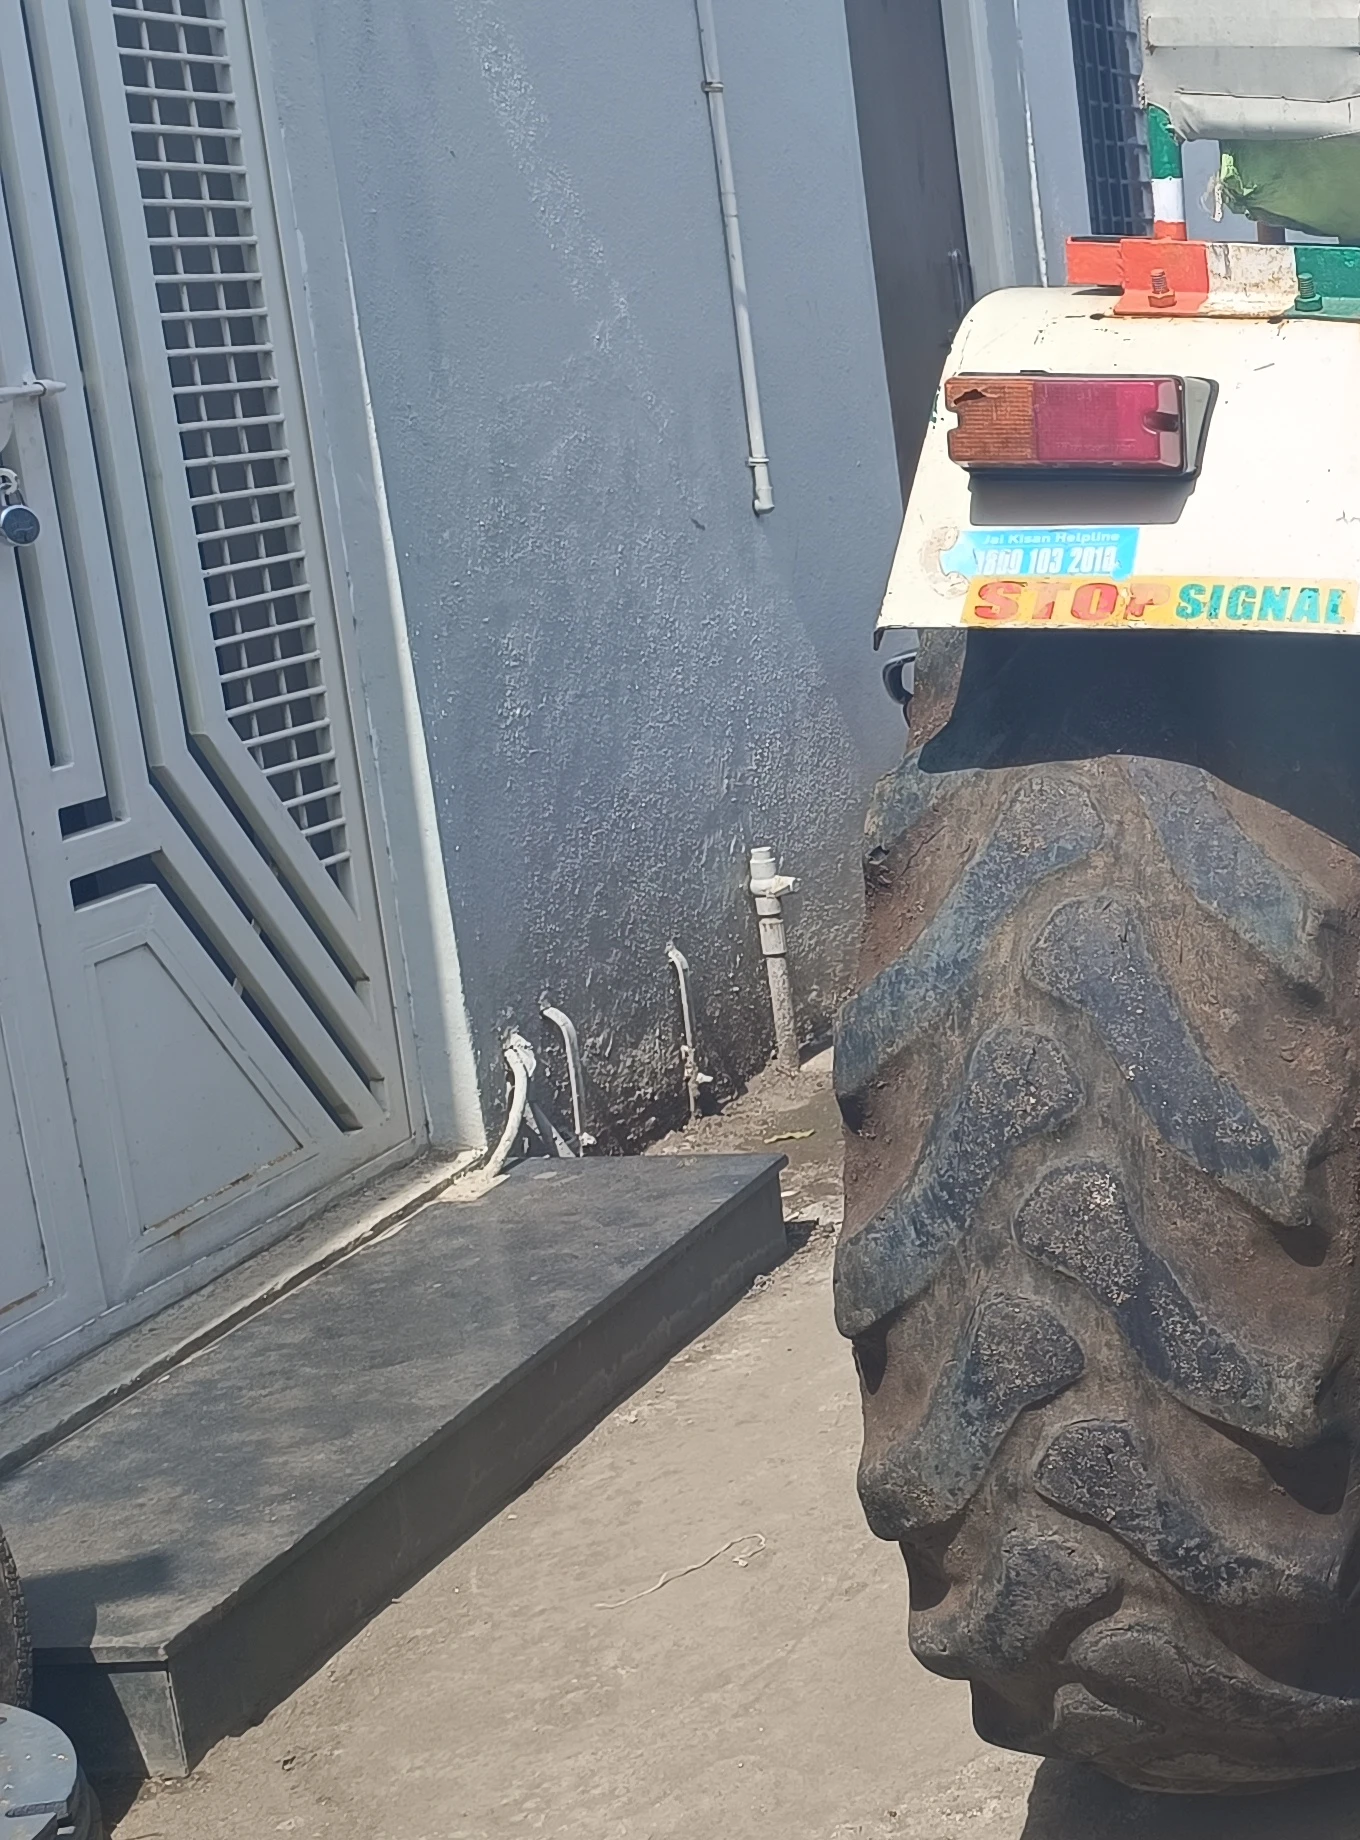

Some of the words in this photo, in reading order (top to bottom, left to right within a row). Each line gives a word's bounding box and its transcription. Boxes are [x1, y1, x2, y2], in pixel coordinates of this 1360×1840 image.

[983, 535, 1004, 545] Jai
[1008, 533, 1051, 545] Kisan
[1055, 531, 1120, 545] Helpline
[1028, 547, 1065, 574] 103
[973, 580, 1171, 621] STOP
[1175, 583, 1346, 625] SIGNAL
